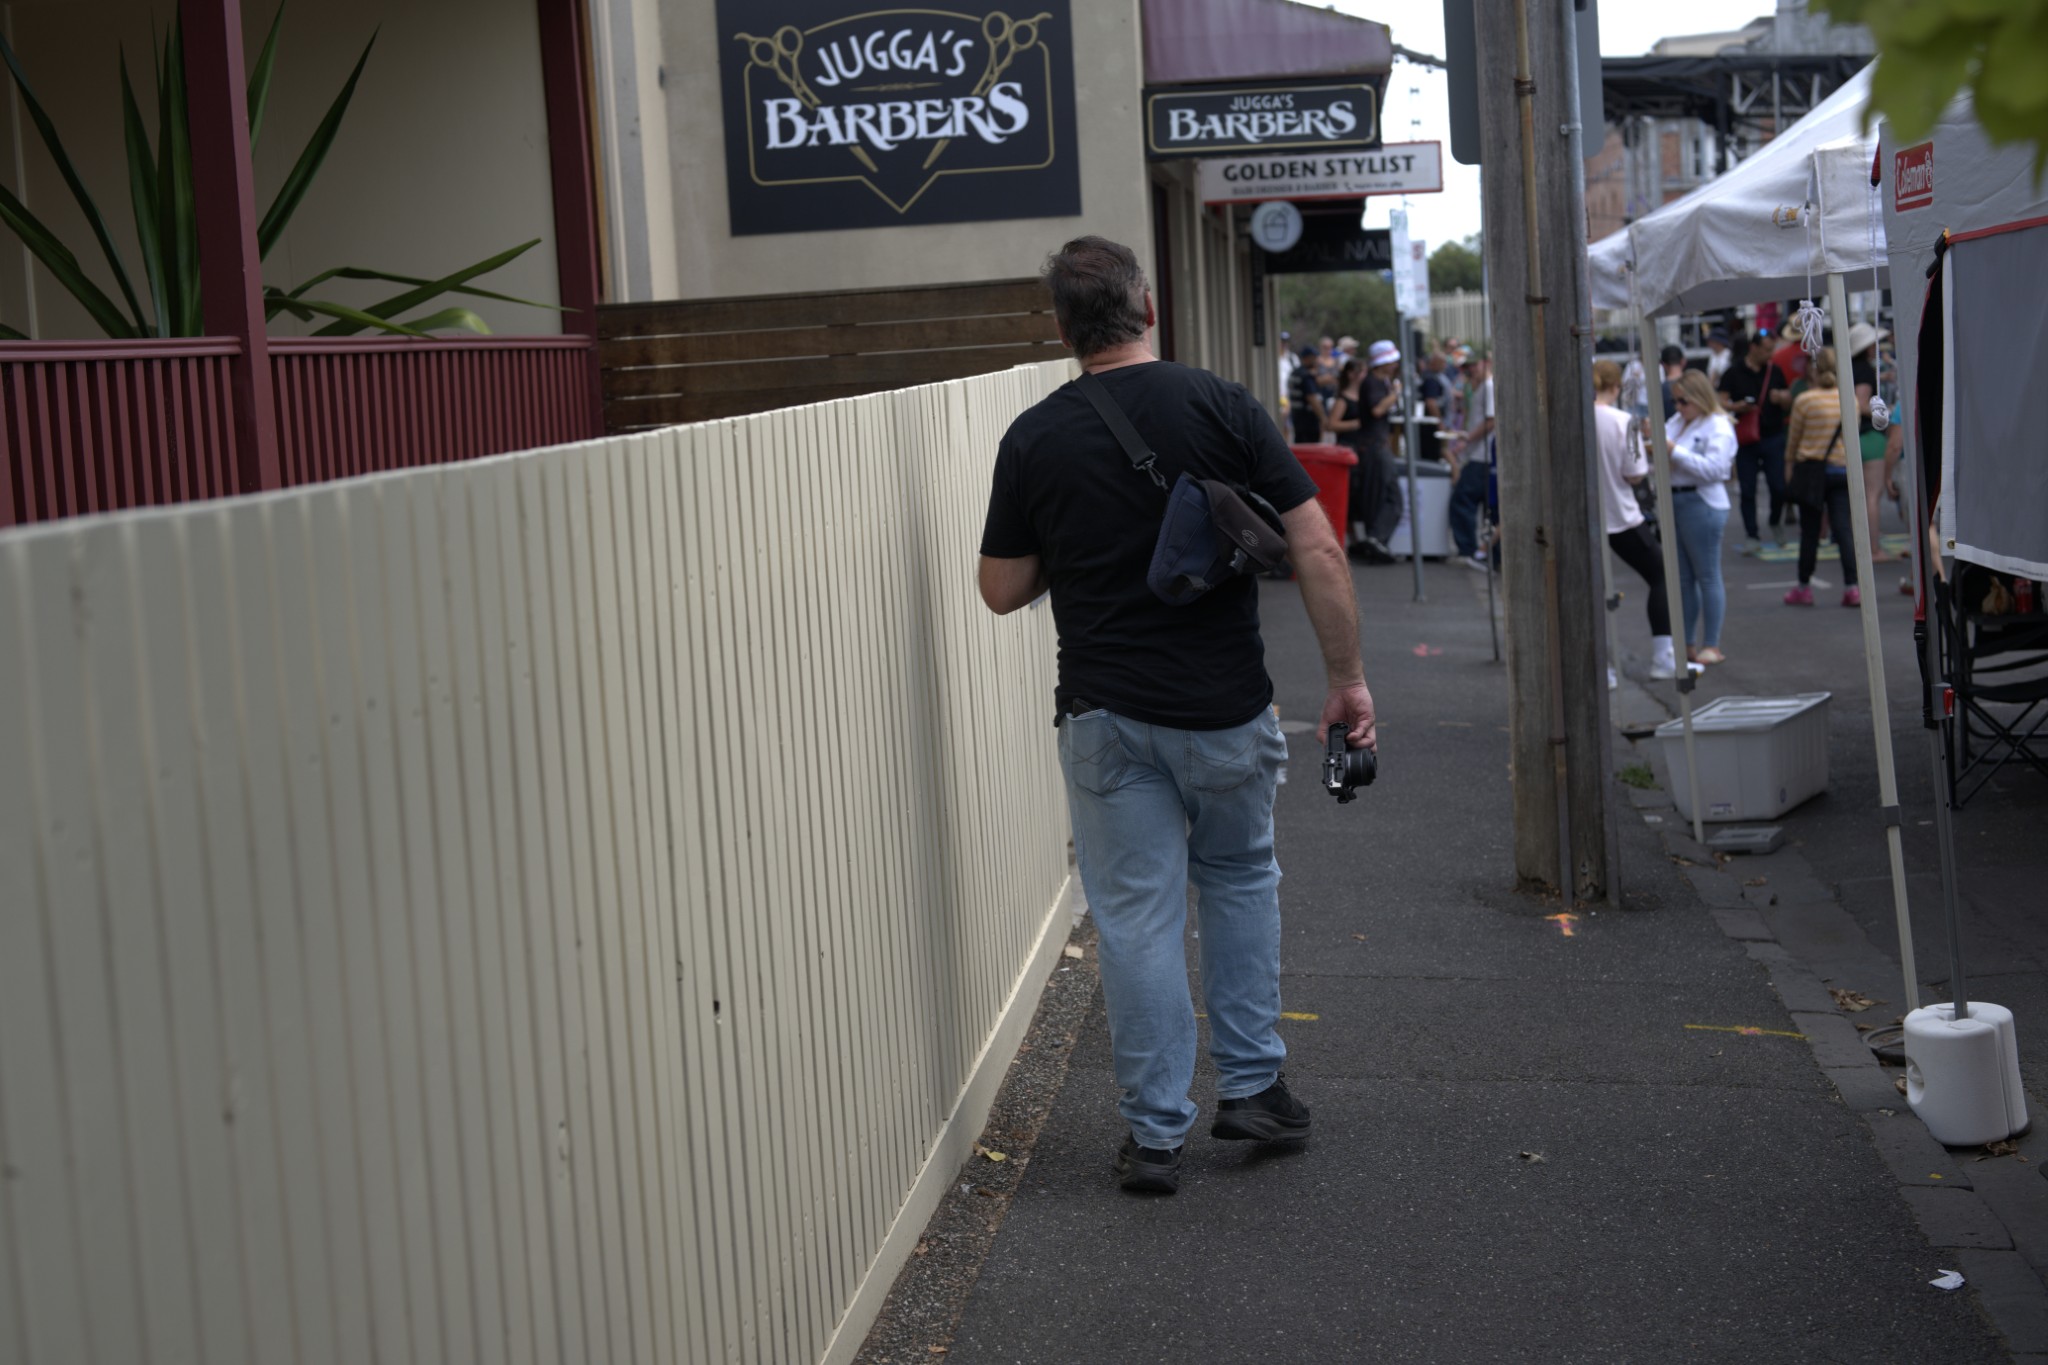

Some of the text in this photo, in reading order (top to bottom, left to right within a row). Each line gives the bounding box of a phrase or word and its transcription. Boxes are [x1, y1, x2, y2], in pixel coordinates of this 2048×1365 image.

[815, 29, 974, 87] JUGGA'S
[763, 82, 1030, 151] BARBERS
[1168, 101, 1357, 143] BARBERS
[1229, 94, 1295, 111] JUGGA'S
[1223, 155, 1416, 181] GOLDEN STYLIST
